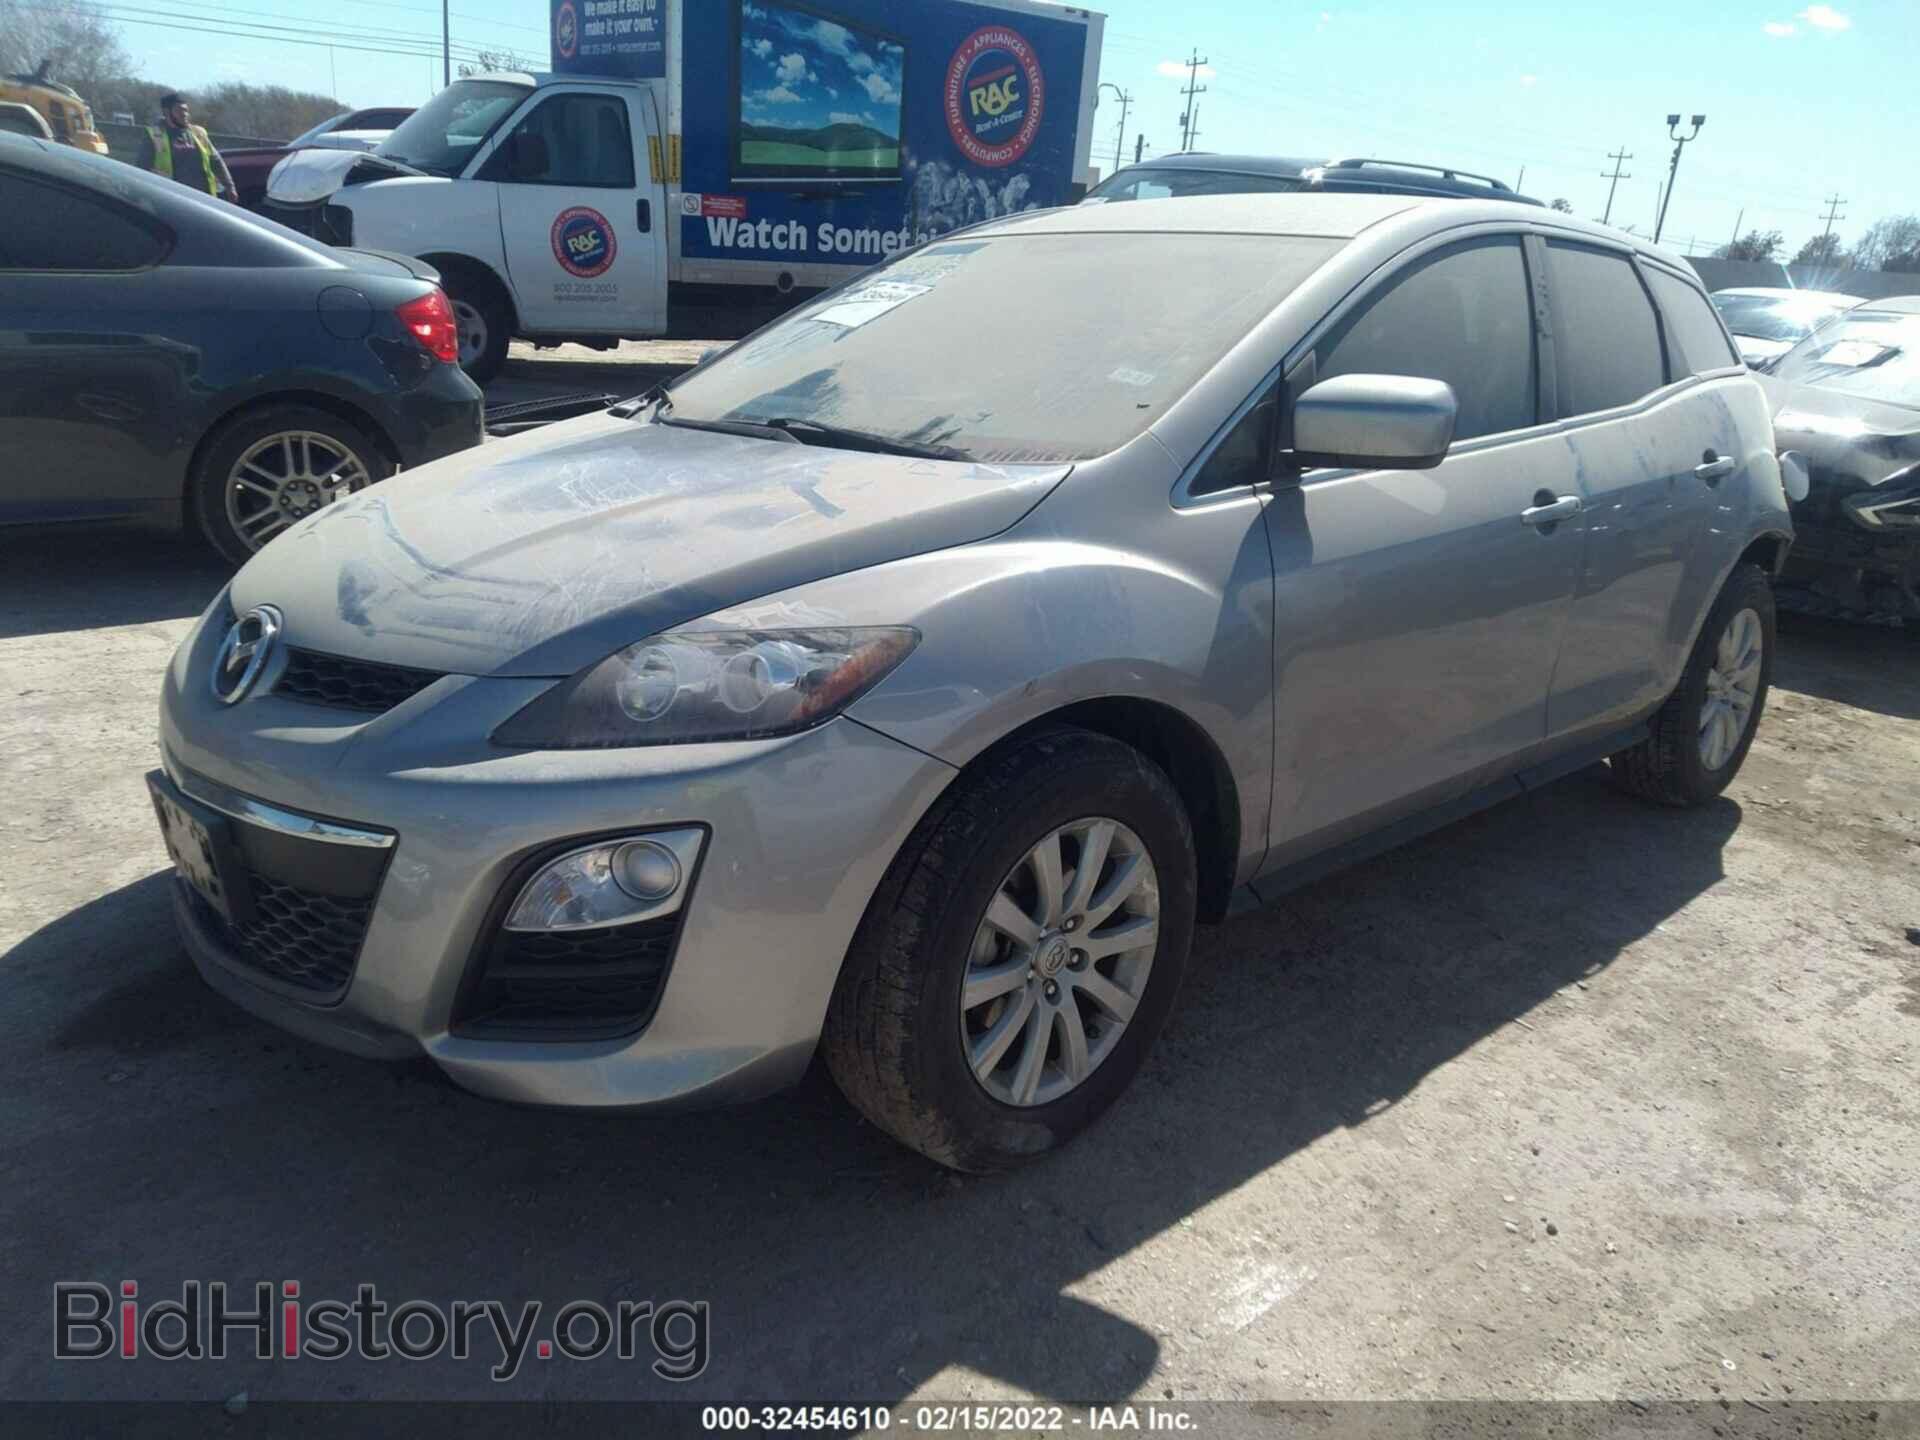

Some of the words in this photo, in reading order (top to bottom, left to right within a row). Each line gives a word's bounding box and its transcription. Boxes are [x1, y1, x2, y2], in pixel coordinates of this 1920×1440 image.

[585, 19, 605, 35] make
[614, 18, 632, 36] your
[973, 31, 1027, 57] APPLIANCES
[949, 55, 968, 125] FURNITURE
[969, 74, 1020, 116] RAC
[1021, 64, 1041, 145] ELECTRONICS
[962, 134, 1013, 161] COMPUTERS
[567, 230, 601, 253] RAC
[706, 216, 808, 251] Watch
